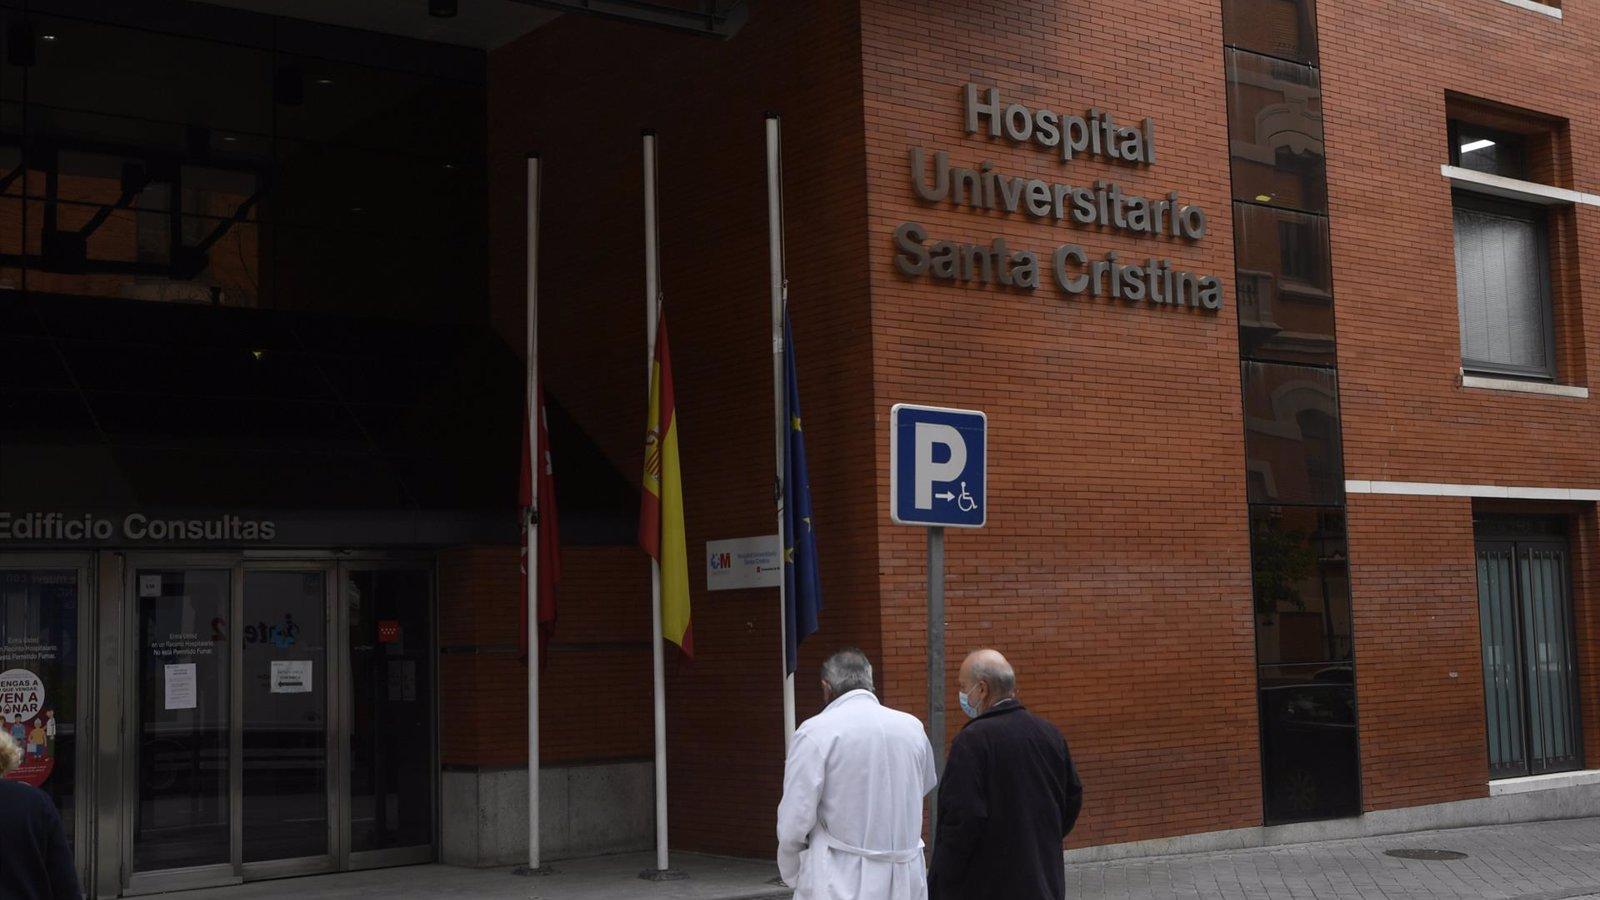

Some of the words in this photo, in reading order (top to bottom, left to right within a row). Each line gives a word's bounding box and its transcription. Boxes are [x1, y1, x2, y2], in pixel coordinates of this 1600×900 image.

[963, 83, 1155, 166] Hospital
[909, 149, 1206, 241] Universitario
[894, 221, 1039, 292] Santa
[1055, 243, 1223, 311] Cristina
[914, 421, 968, 510] P
[0, 512, 112, 540] Edificio
[123, 512, 276, 540] Consultas
[0, 703, 37, 713] ONAR
[28, 692, 38, 702] A
